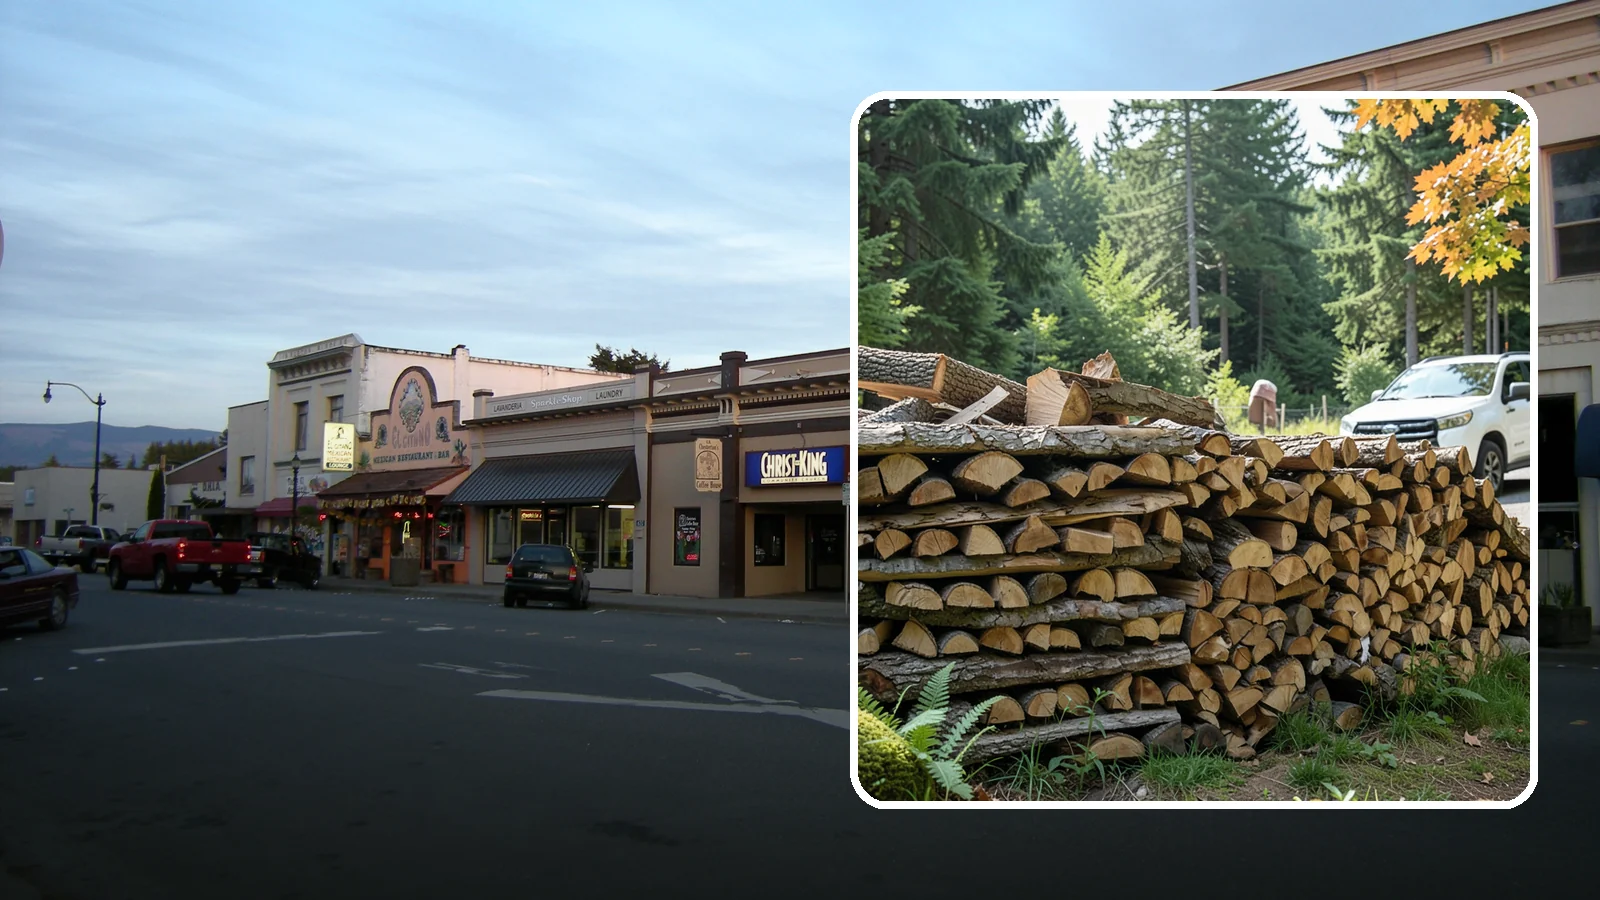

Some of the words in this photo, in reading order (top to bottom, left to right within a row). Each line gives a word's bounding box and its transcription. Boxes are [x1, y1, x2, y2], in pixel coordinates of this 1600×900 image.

[561, 394, 583, 404] Shop
[595, 388, 623, 400] LAUNDRY
[493, 402, 523, 413] LAVANDERIA
[373, 454, 396, 464] MEXICAN
[397, 451, 433, 462] RESTAURANT
[437, 450, 450, 459] BAR
[761, 452, 797, 477] CHRIST
[800, 450, 827, 476] KING
